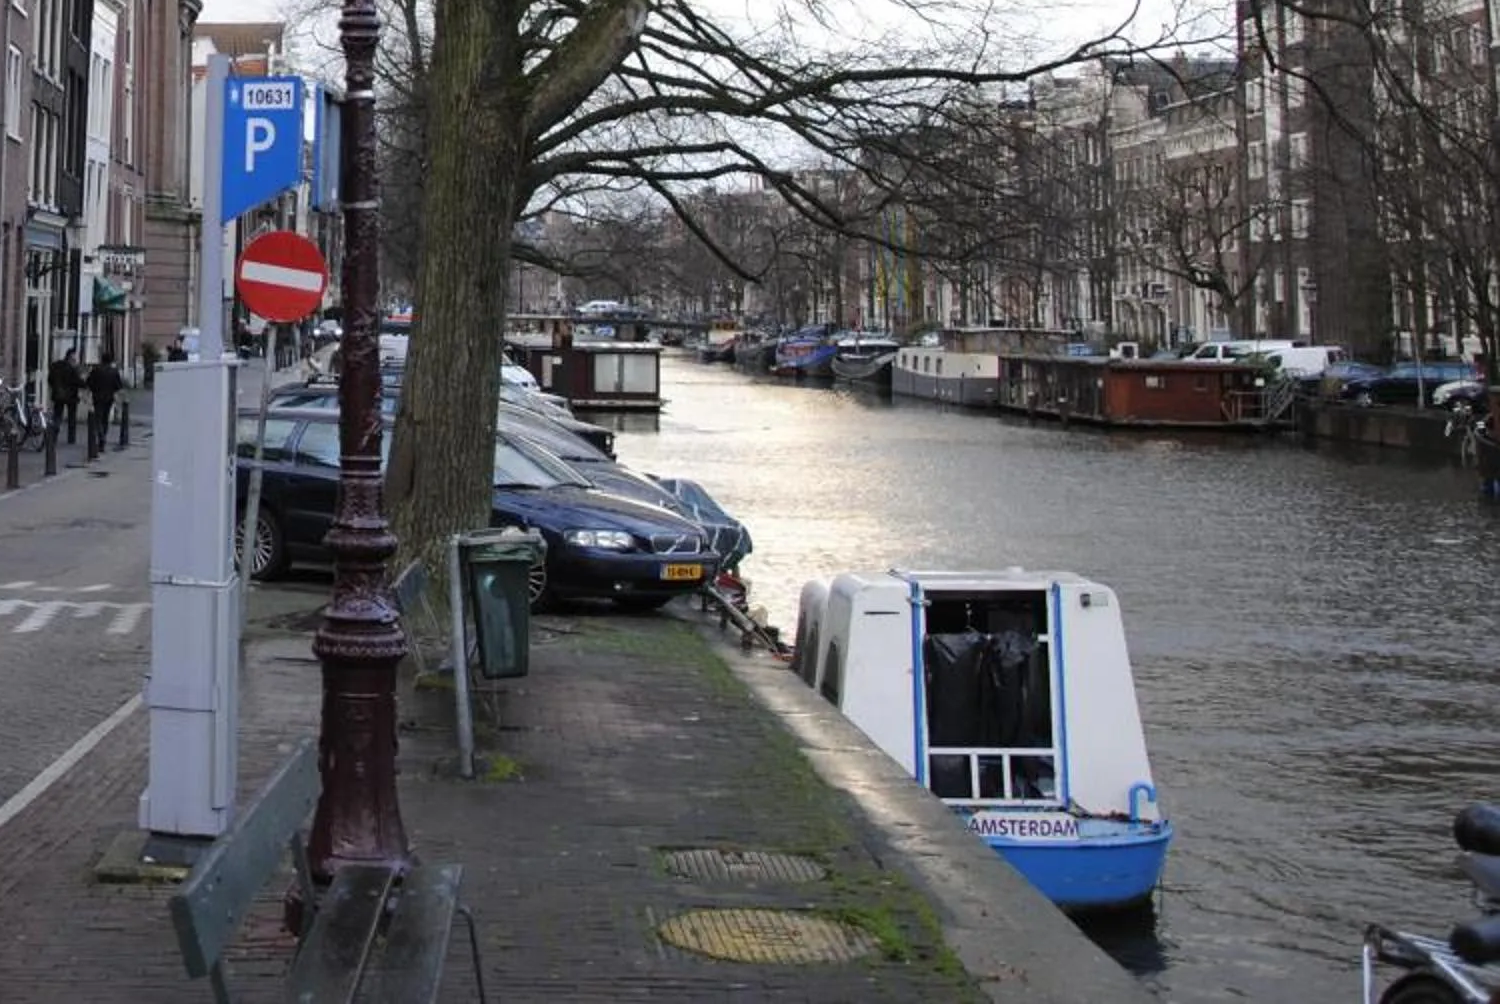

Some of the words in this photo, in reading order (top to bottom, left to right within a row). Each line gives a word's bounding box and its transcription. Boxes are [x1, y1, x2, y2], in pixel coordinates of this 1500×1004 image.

[248, 88, 291, 105] 10631
[245, 117, 276, 172] P
[968, 818, 1079, 837] AMSTERDAM
